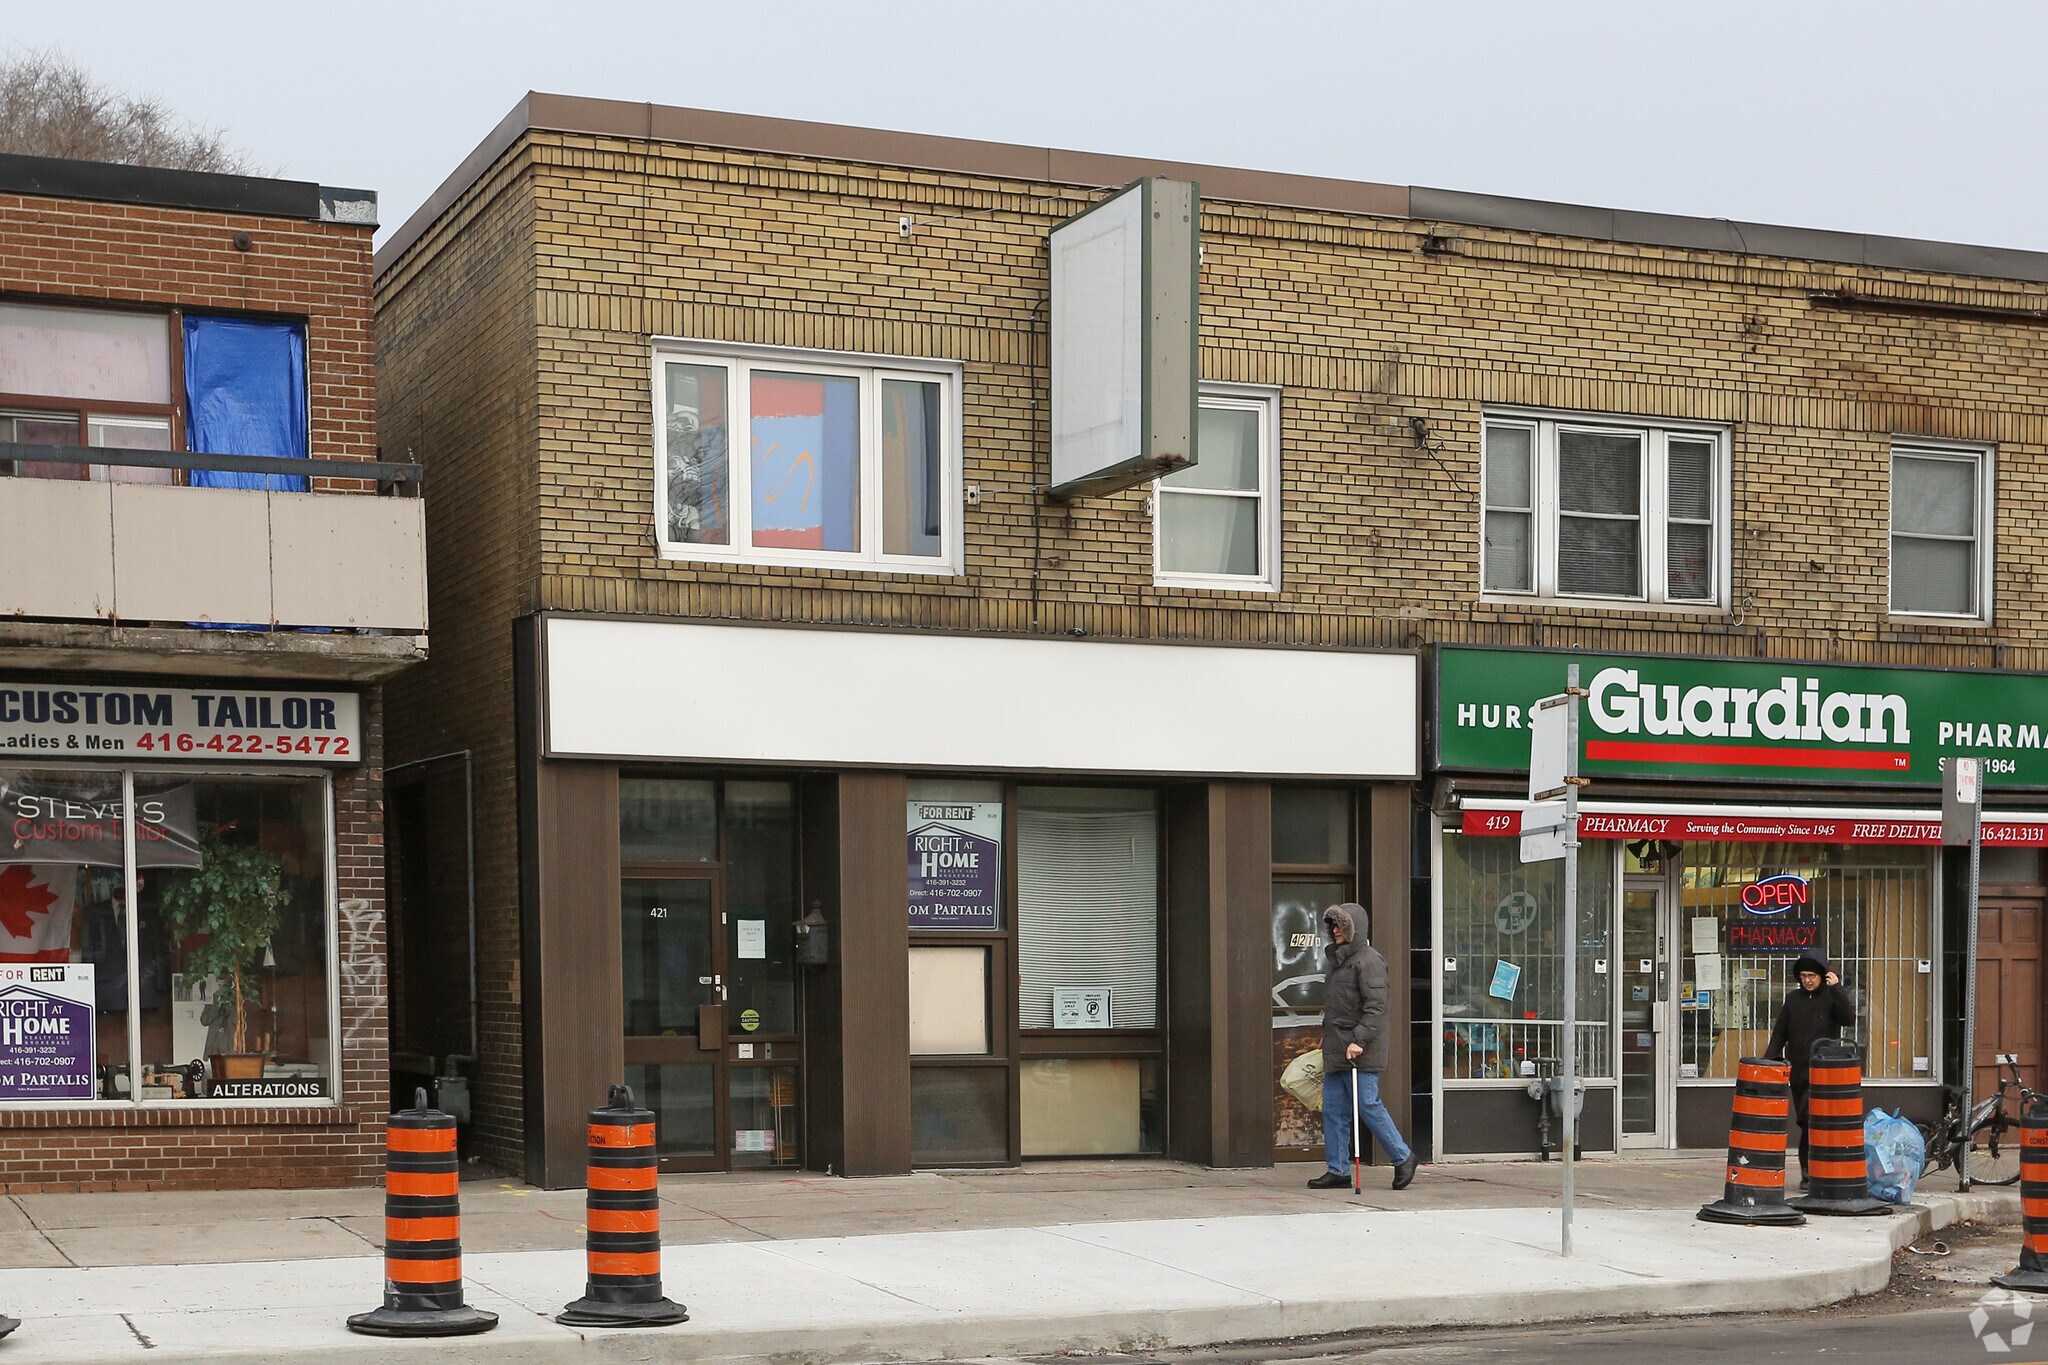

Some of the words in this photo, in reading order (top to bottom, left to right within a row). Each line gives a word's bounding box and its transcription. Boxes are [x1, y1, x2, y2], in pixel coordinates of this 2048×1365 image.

[0, 690, 174, 727] CUSTOM
[191, 695, 337, 730] TAILOR
[1587, 667, 1910, 744] Guardian
[1939, 721, 2048, 749] PHARM
[66, 734, 79, 749] &
[86, 735, 124, 750] Men
[136, 732, 350, 755] 416-422-5472
[1894, 758, 1907, 767] TM
[1984, 759, 2016, 774] 1964
[17, 795, 166, 824] STEVE'S
[923, 806, 943, 819] FOR
[945, 807, 972, 820] RENT
[13, 818, 103, 841] Custom
[108, 818, 169, 842] Tilor
[1485, 815, 1511, 831] 419
[1583, 816, 1671, 834] PHARMACY
[1686, 821, 1719, 836] Serving
[1721, 822, 1735, 834] the
[1736, 823, 1787, 837] Community
[1788, 824, 1811, 835] Since
[1813, 824, 1836, 836] 1945
[1851, 823, 1887, 838] FREE
[915, 836, 962, 852] RIGHT
[963, 841, 975, 850] AT
[921, 852, 979, 878] HOME
[909, 889, 929, 897] Direct:
[929, 889, 983, 898] 416-702-0907
[1742, 882, 1808, 906] OPEN
[650, 907, 667, 918] 421
[934, 903, 993, 916] PARTALIS
[1730, 926, 1817, 946] PHARMACY
[32, 968, 63, 981] RENT
[51, 1005, 64, 1015] AT
[3, 1018, 70, 1046] HOME
[9, 1046, 57, 1054] 416-391-3232
[14, 1057, 76, 1066] 416-702-0907
[20, 1072, 89, 1086] PARTALIS
[213, 1083, 320, 1097] ALTERATIONS
